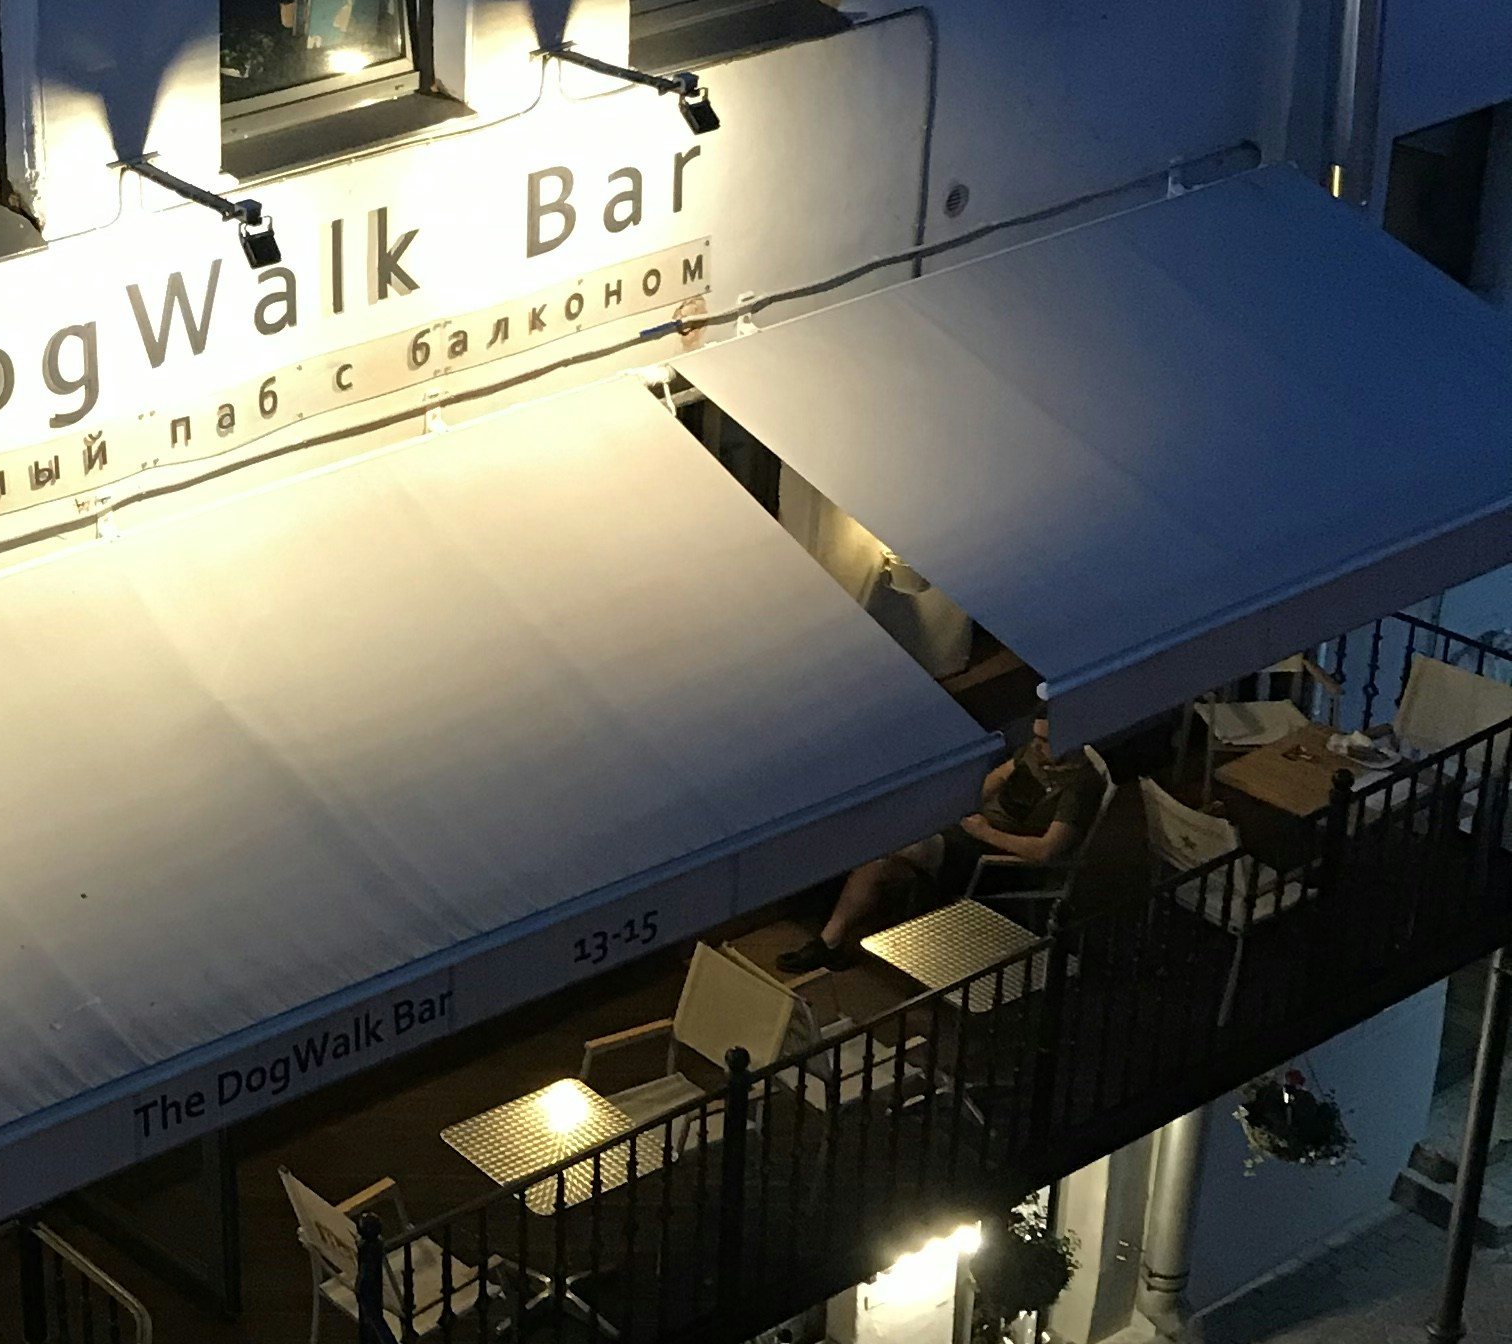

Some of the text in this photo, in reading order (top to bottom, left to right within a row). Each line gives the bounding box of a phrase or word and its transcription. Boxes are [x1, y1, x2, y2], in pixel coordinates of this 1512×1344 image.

[526, 145, 701, 258] Bar
[171, 376, 279, 448] паб
[333, 362, 355, 393] с
[409, 253, 705, 369] балконом
[572, 909, 659, 966] 13-15
[134, 1090, 206, 1137] The
[393, 990, 454, 1036] Bar
